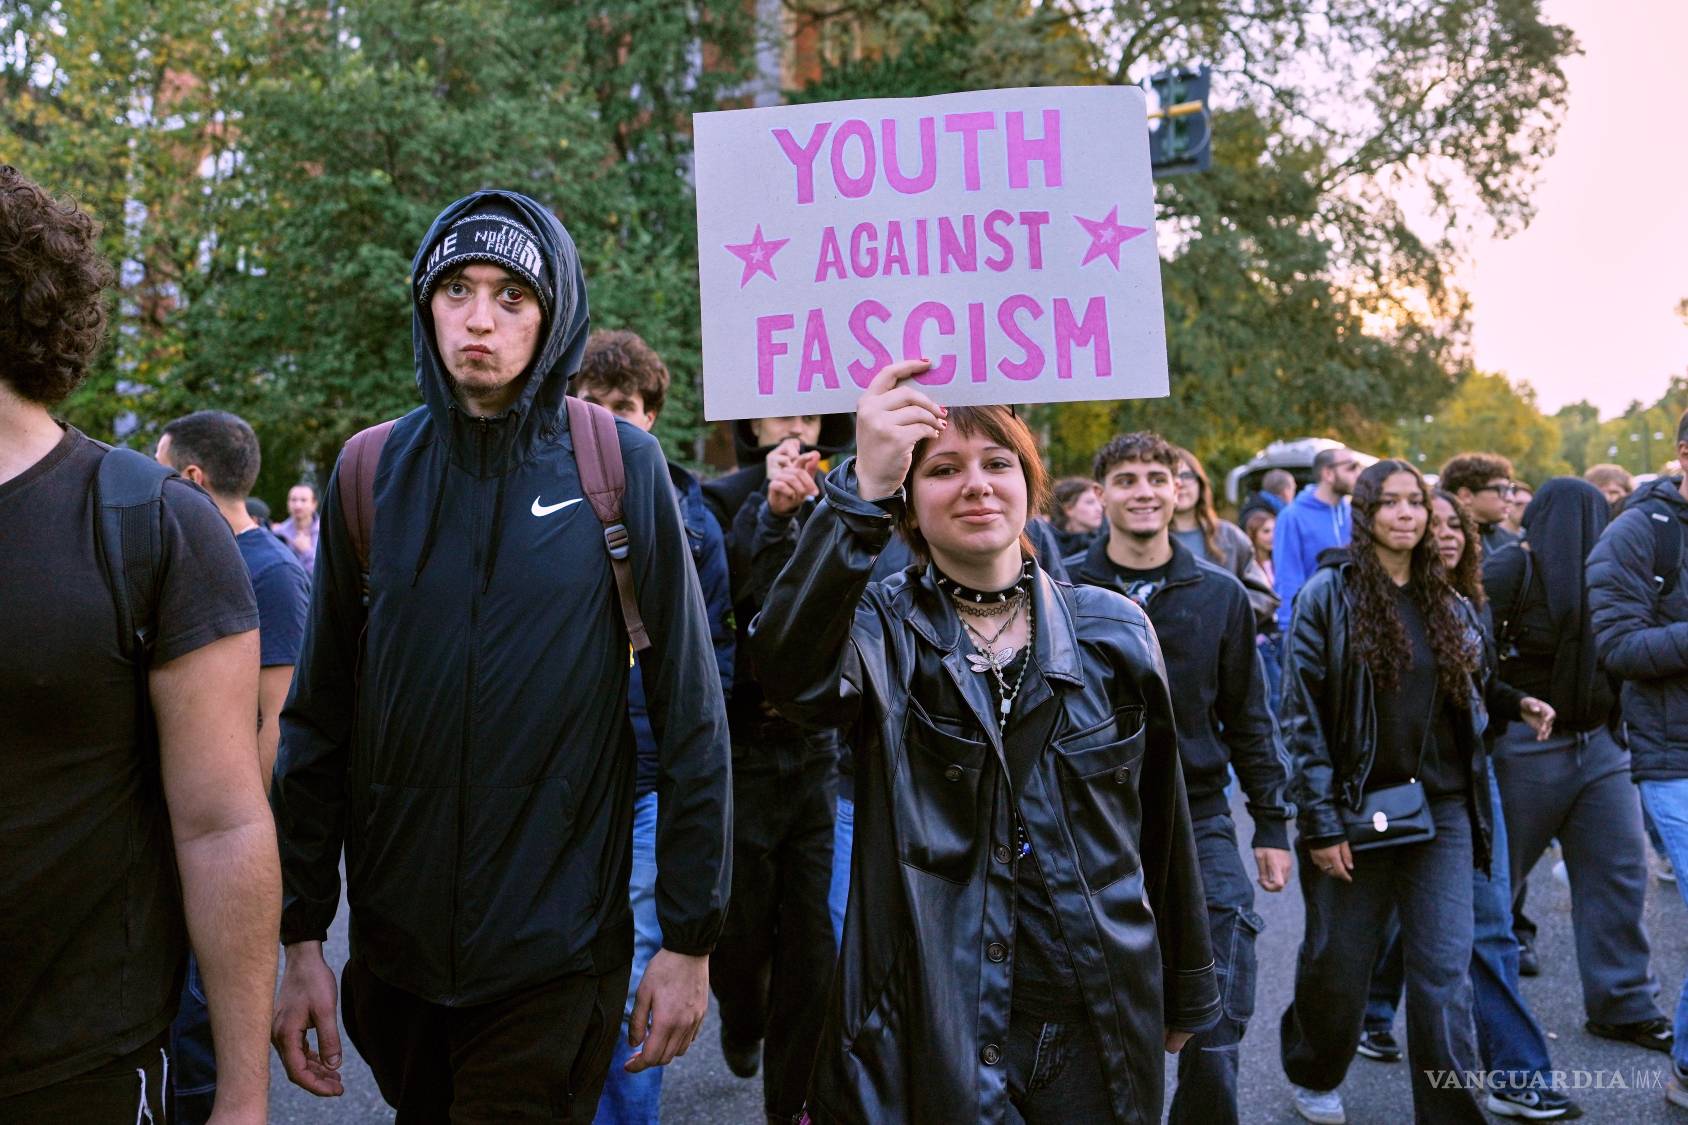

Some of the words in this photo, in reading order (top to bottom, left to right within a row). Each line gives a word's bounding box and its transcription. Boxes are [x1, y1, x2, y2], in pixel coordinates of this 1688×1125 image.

[771, 109, 1062, 204] YOUTH
[475, 231, 523, 252] NORTH
[486, 241, 519, 261] FACE
[502, 225, 526, 242] THE
[814, 209, 1050, 283] AGAINST
[757, 294, 1112, 395] FASCISM
